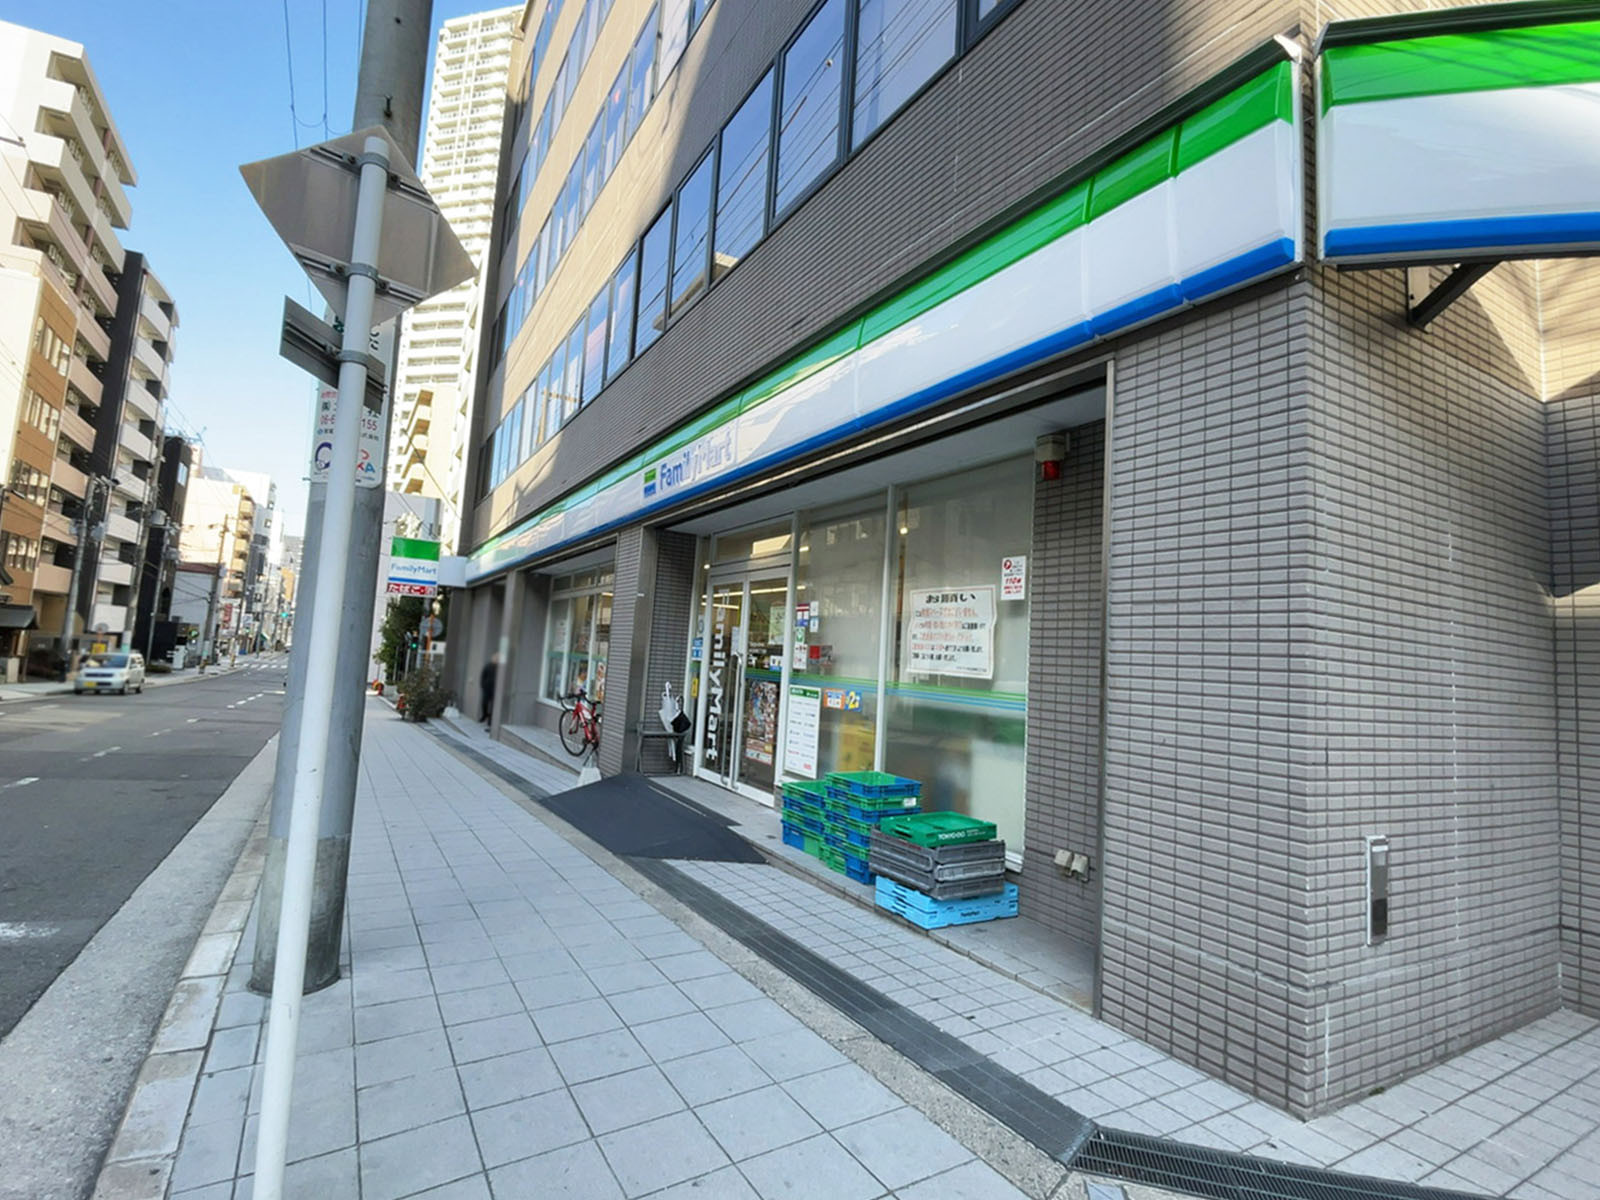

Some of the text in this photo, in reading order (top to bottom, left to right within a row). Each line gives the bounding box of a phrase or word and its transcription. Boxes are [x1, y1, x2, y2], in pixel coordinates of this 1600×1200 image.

[660, 430, 732, 490] FamilyMart
[391, 563, 437, 574] FamilyMart
[925, 593, 977, 604] お願い
[705, 589, 730, 760] FamilyMart
